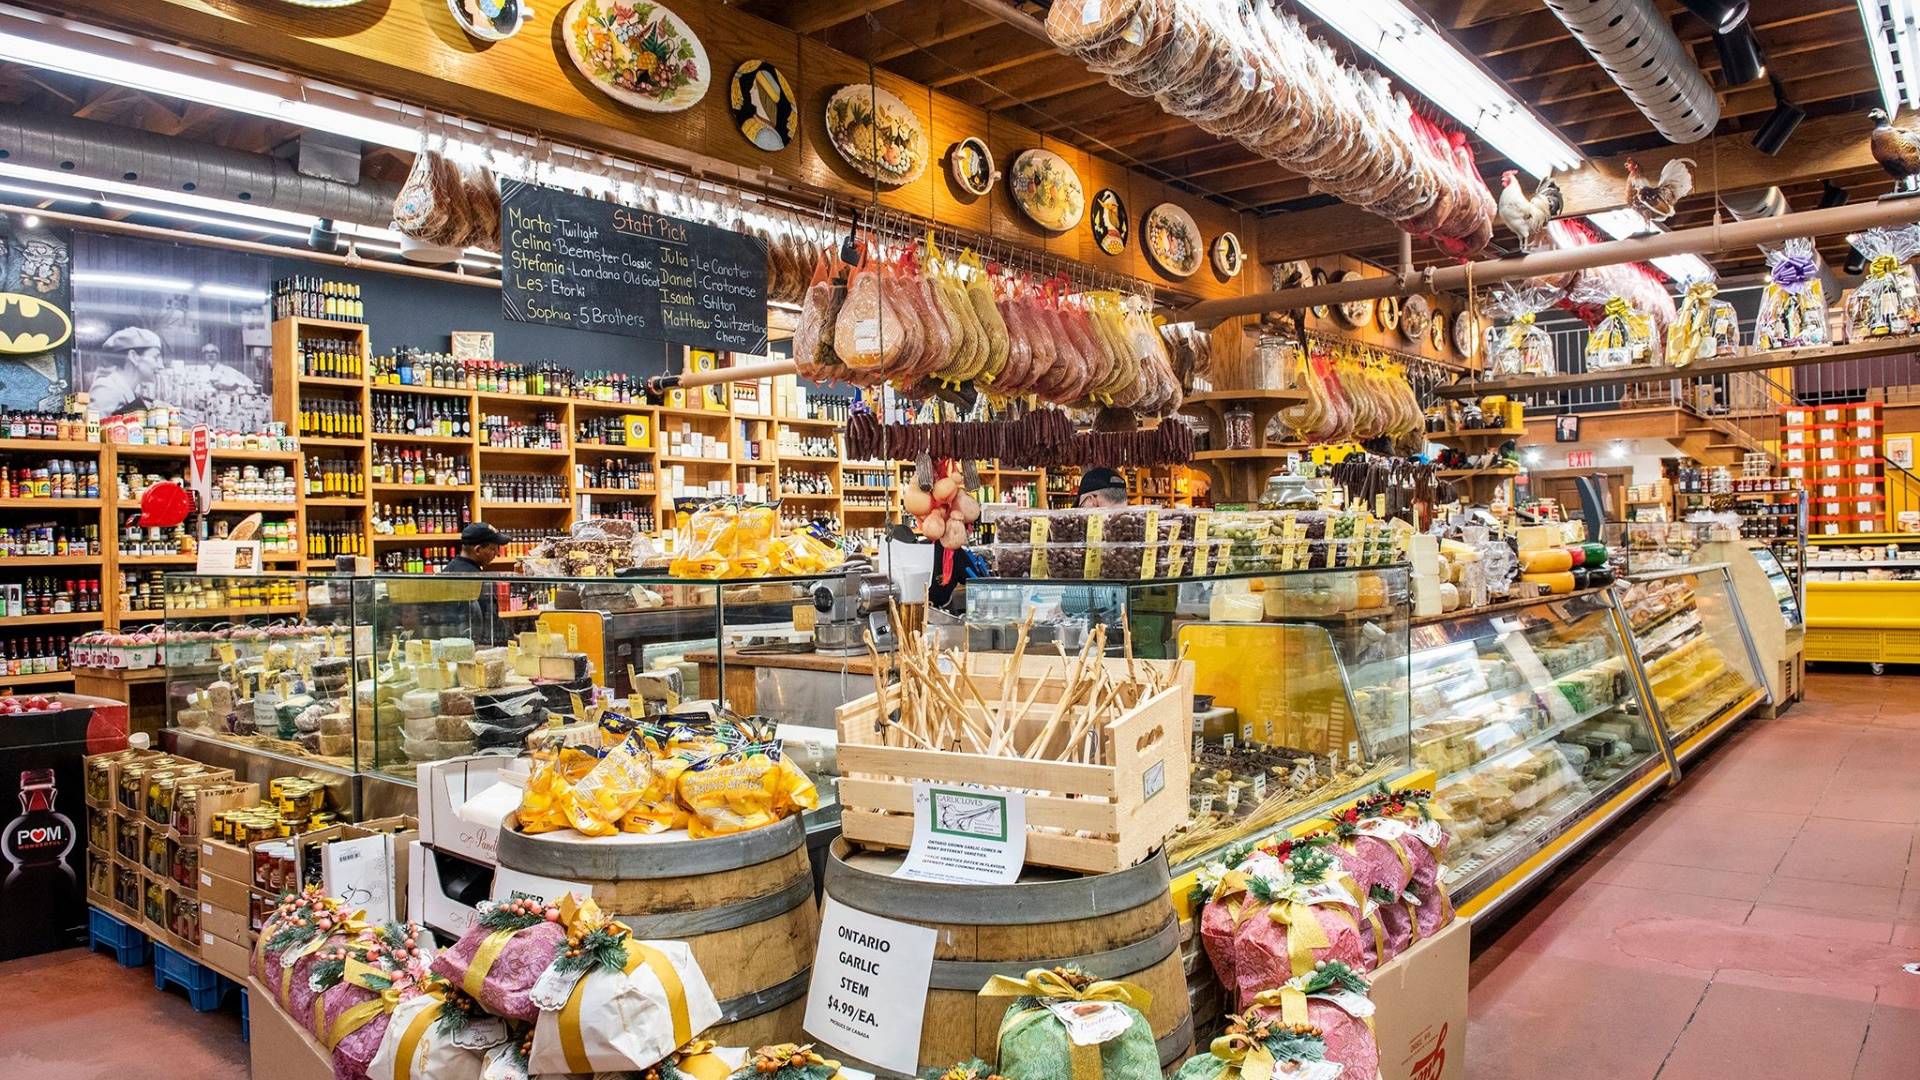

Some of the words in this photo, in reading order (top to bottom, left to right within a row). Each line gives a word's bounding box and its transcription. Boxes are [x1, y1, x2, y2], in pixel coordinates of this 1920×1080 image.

[612, 208, 654, 235] Staff
[656, 217, 688, 242] Pick
[621, 252, 652, 270] Classic
[623, 271, 640, 285] Old
[580, 306, 590, 324] 5
[591, 307, 645, 328] Brothers
[715, 330, 746, 346] Chevre
[1568, 450, 1593, 467] EXIT
[17, 826, 61, 845] POM
[838, 925, 891, 953] ONTARIO
[839, 951, 880, 976] GARLIC
[840, 977, 869, 998] STEM
[827, 994, 879, 1028] $4.99/EA.
